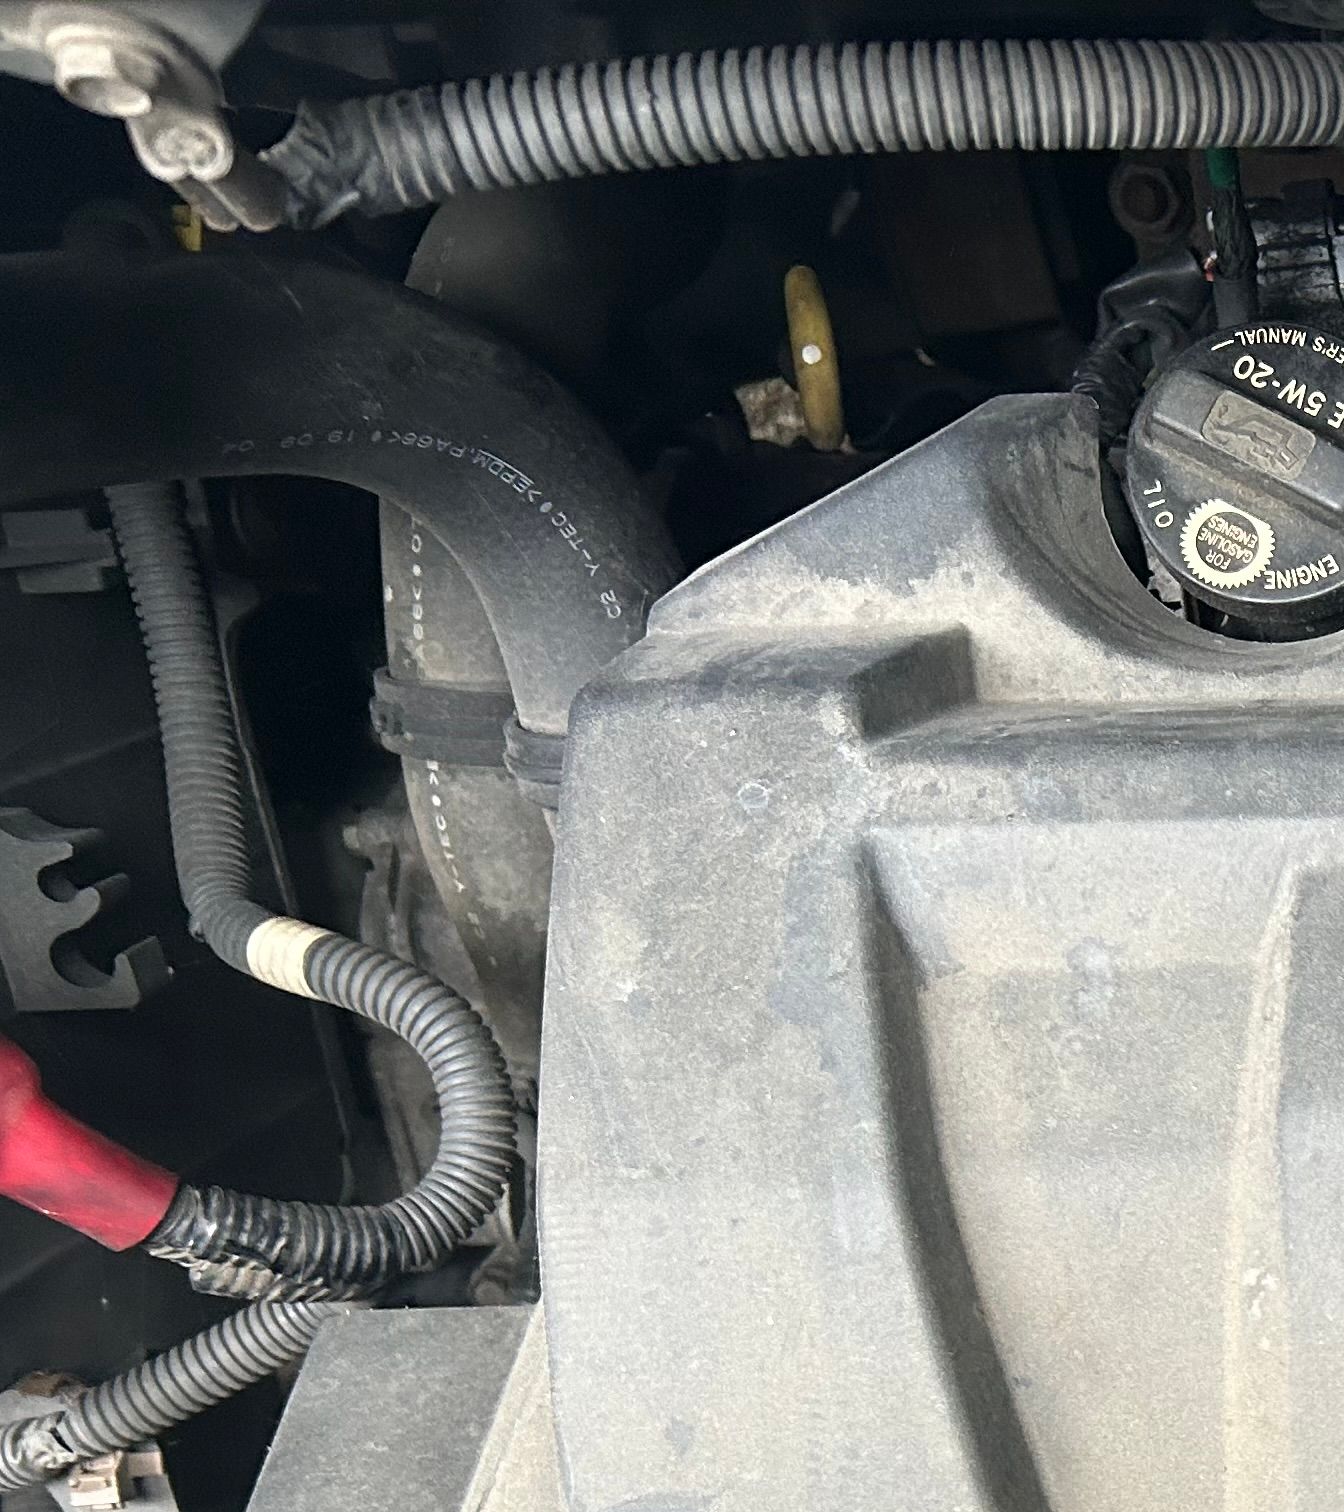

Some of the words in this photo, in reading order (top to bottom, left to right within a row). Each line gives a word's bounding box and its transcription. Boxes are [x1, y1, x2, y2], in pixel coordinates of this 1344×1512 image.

[1234, 327, 1307, 347] MANUAL
[1233, 355, 1327, 417] 5W-20
[1143, 478, 1174, 528] OIL
[550, 511, 601, 577] Y-TEC
[1197, 527, 1254, 564] GASOLINE
[1207, 515, 1258, 549] ENGINES
[1205, 549, 1233, 570] FOR
[1263, 553, 1341, 590] ENGINE
[600, 588, 622, 619] C2
